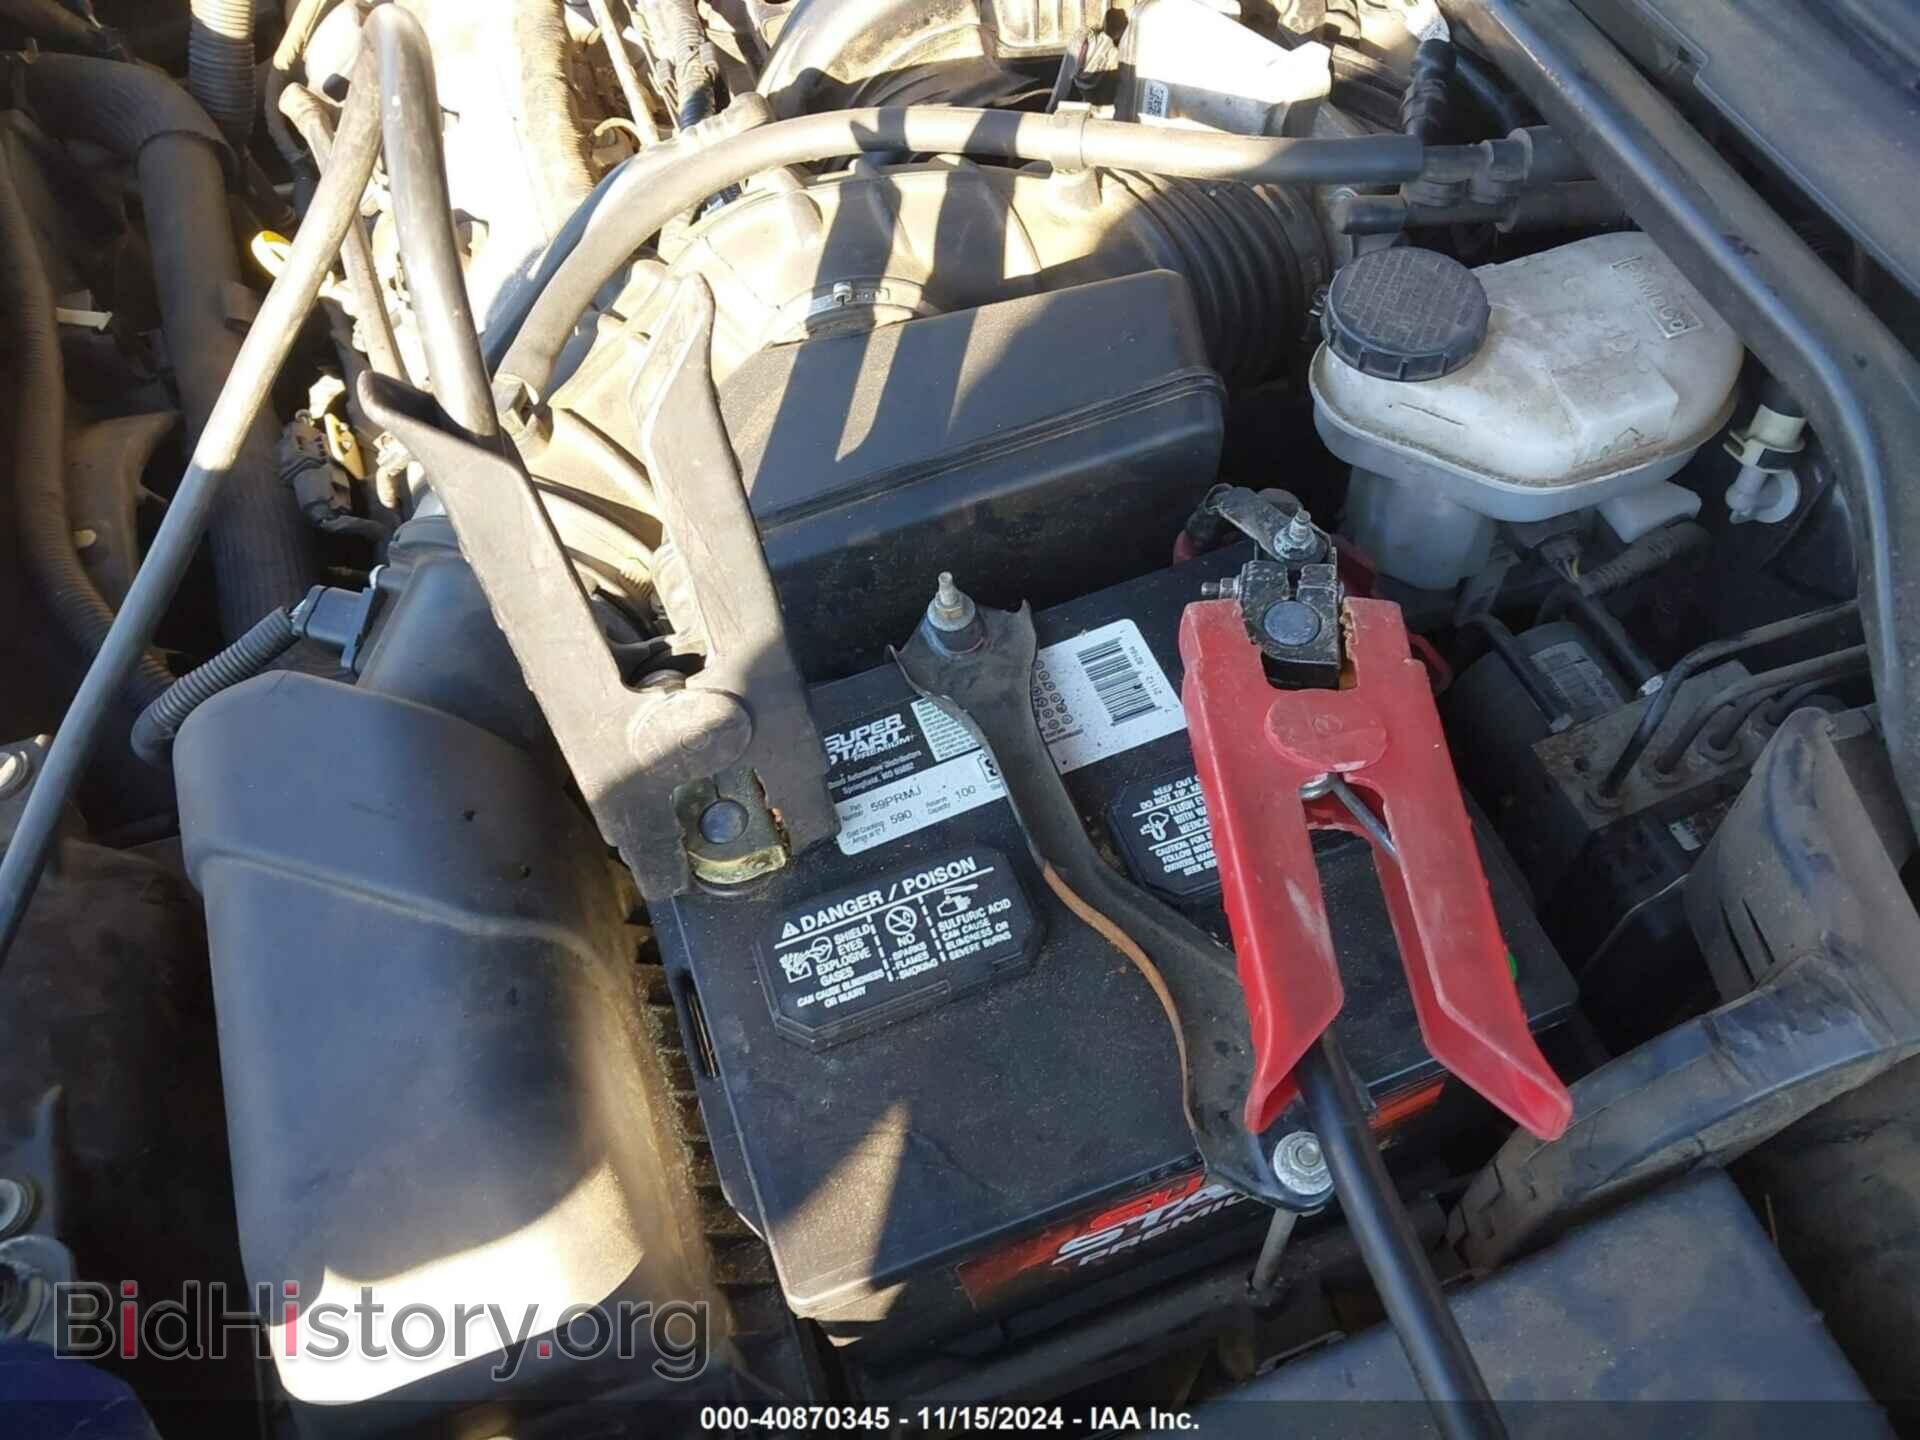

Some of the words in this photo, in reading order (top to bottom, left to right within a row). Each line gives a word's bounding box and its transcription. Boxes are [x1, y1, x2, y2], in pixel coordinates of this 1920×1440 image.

[824, 713, 902, 754] SUPER
[955, 785, 977, 801] 100
[889, 809, 912, 825] 590
[799, 889, 884, 933] DANGER
[887, 883, 898, 902] /
[902, 856, 976, 896] POISON
[937, 907, 987, 933] SULFURIC
[987, 897, 1012, 915] ACID
[833, 923, 872, 945] SHIELD
[897, 932, 916, 948] NO
[941, 928, 961, 942] CAN
[961, 916, 991, 934] CAUSE
[944, 926, 994, 952] BLINDNESS
[995, 920, 1010, 933] OR
[837, 937, 865, 957] EYES
[892, 941, 927, 961] SPARKS
[816, 945, 873, 977] EXPLOSIVE
[895, 950, 930, 970] FLAMES
[820, 965, 856, 988] GASES
[823, 996, 838, 1008] OR
[1052, 1184, 1234, 1265] STA
[1079, 1194, 1248, 1267] PREMIU
